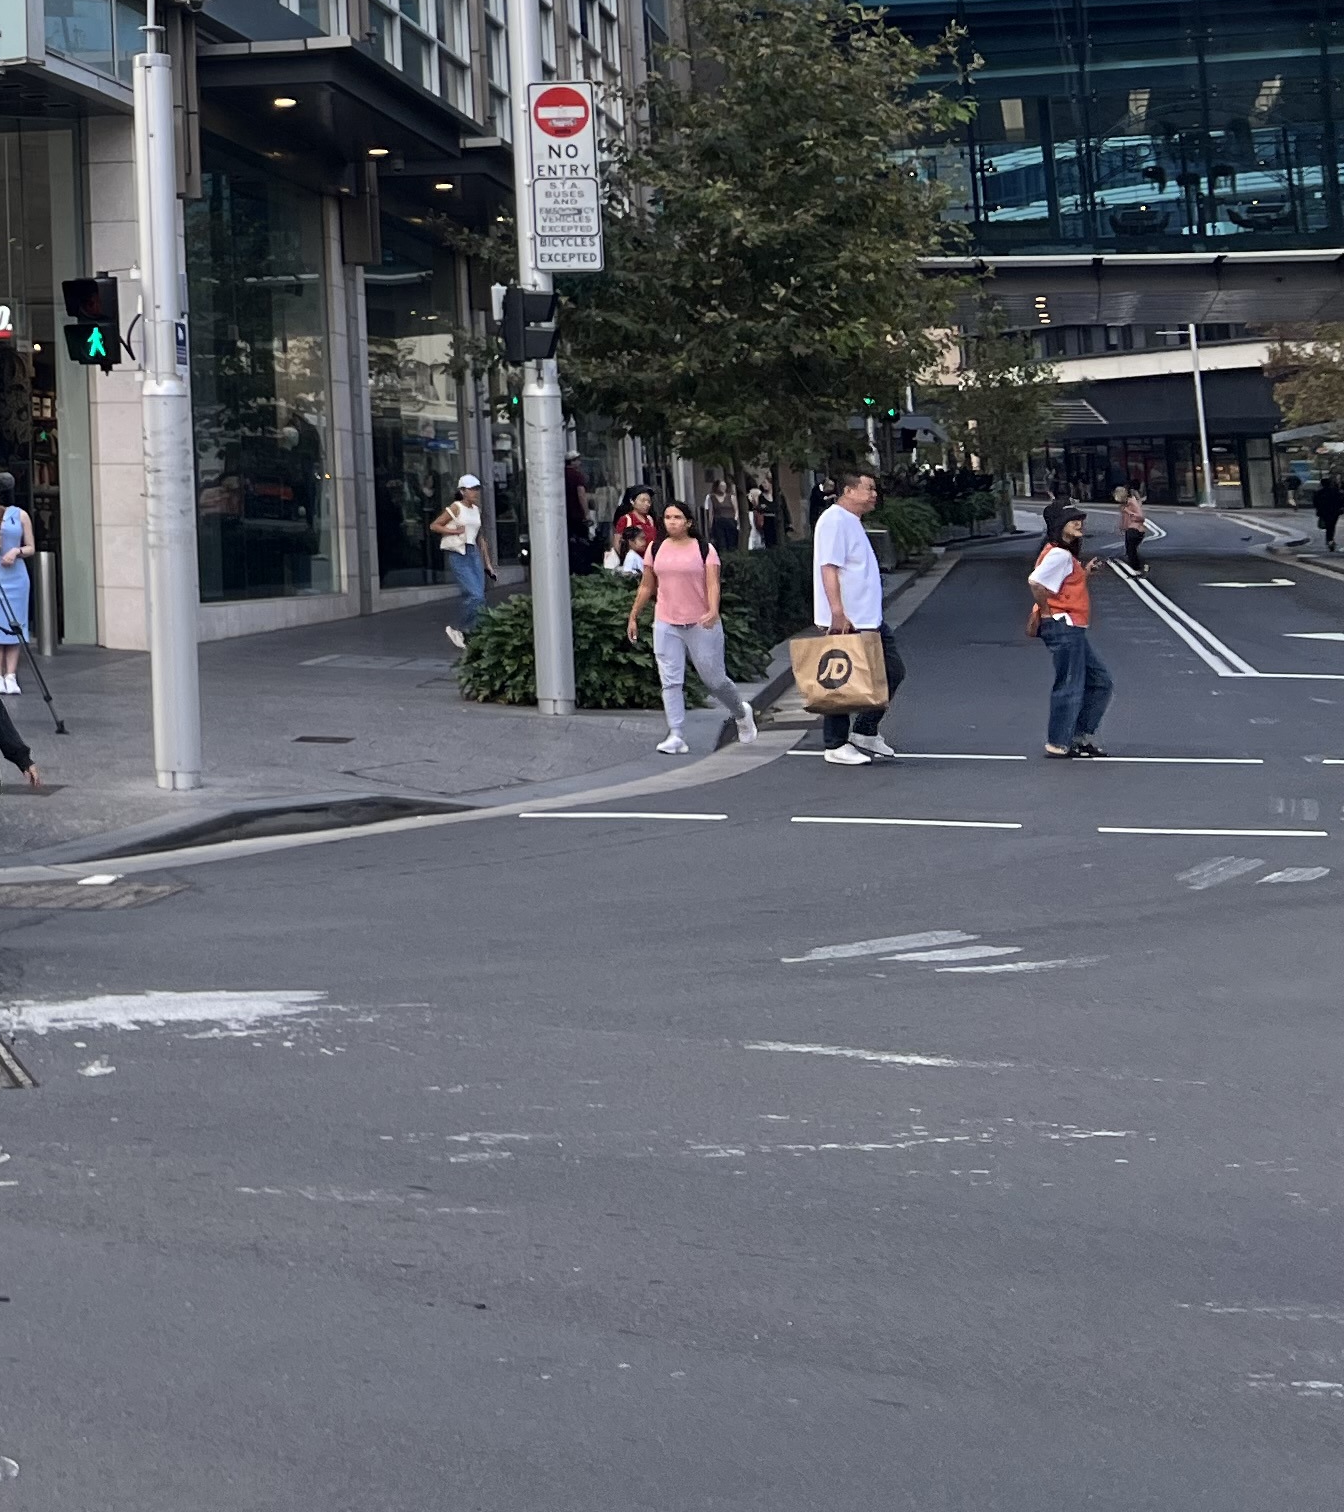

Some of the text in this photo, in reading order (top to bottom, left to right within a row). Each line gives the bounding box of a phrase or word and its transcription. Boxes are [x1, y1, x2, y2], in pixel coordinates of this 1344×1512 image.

[548, 144, 579, 159] NO
[537, 164, 591, 177] ENTRY
[544, 190, 585, 199] BUSES
[542, 215, 592, 224] VEHICLES
[541, 225, 593, 233] EXCEPTED
[540, 237, 596, 248] BICYCLES
[539, 253, 597, 263] EXCEPTED
[819, 658, 847, 681] JD
